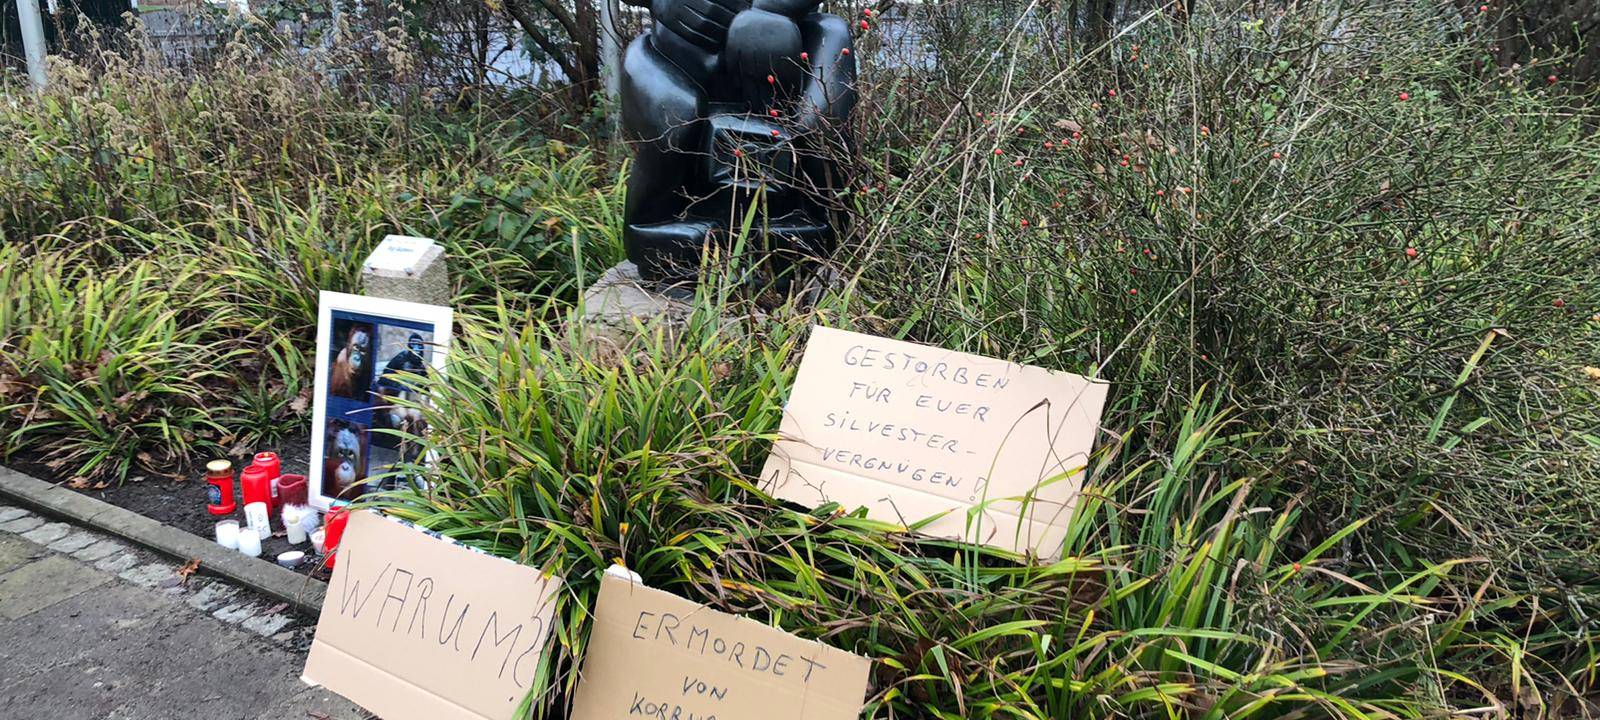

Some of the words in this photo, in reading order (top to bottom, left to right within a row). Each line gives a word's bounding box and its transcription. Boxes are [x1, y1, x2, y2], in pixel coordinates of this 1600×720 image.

[844, 345, 1010, 390] GESTORBEN
[850, 381, 892, 404] FÜR
[915, 394, 991, 423] EUER
[340, 549, 542, 702] WARUM?
[632, 610, 827, 683] ERMORDET
[683, 676, 728, 701] VON
